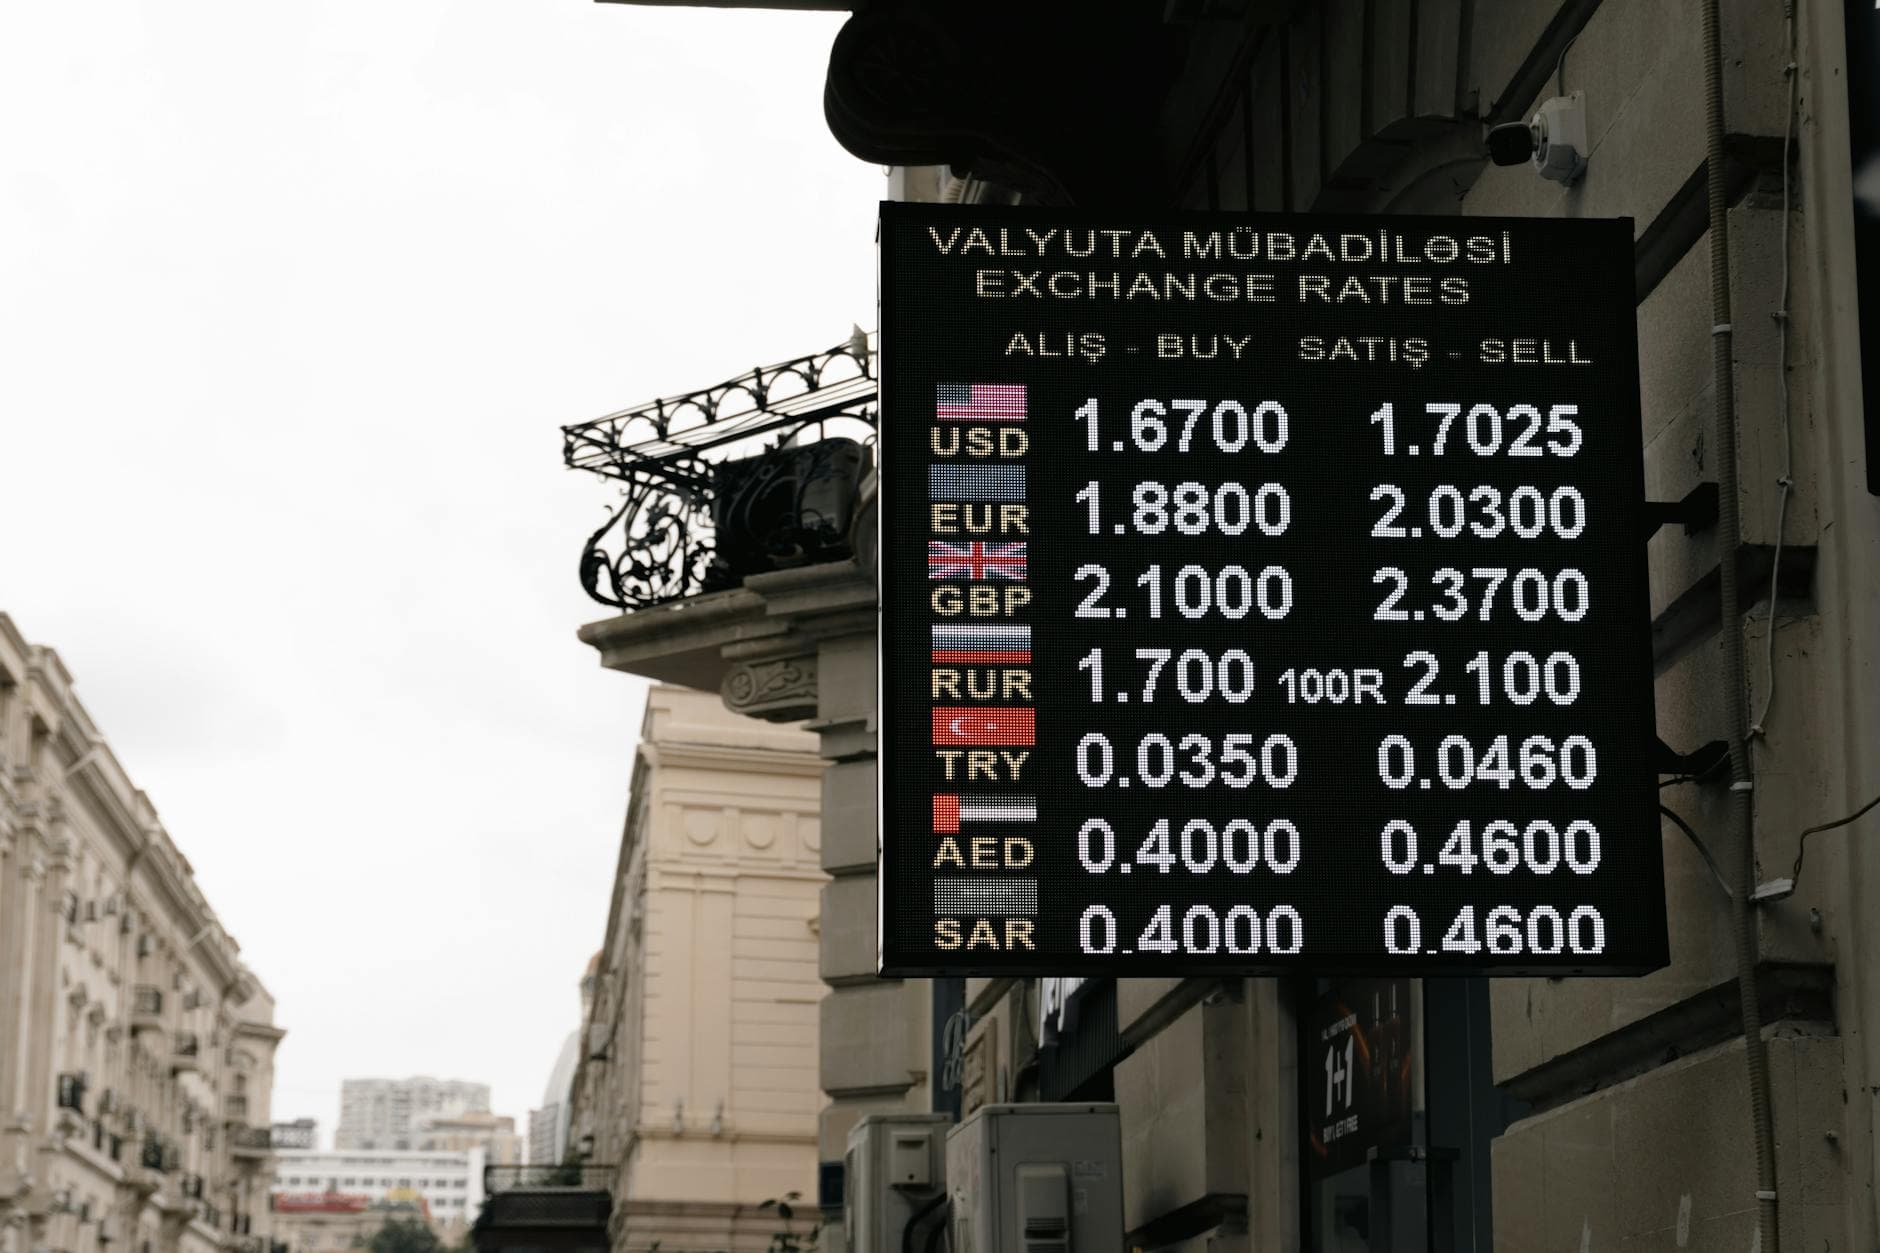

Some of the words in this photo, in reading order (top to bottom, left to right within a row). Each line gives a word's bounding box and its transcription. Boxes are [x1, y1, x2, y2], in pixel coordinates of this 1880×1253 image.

[929, 227, 1165, 258] VALYUTA
[977, 270, 1275, 301] EXCHANGE
[1299, 276, 1468, 304] RATES
[1006, 332, 1105, 365] ALIŞ
[1158, 334, 1250, 358] BUY
[1301, 336, 1427, 370] SATIŞ
[1480, 339, 1593, 363] SELL
[931, 427, 1028, 458] USD
[1075, 398, 1288, 453] 1.6700
[1371, 403, 1582, 456] 1.7025
[932, 504, 1029, 533] EUR
[1076, 481, 1290, 535] 1.8800
[1370, 484, 1585, 538] 2.0300
[932, 585, 1030, 616] GBP
[1074, 564, 1292, 619] 2.1000
[1373, 567, 1589, 621] 2.3700
[932, 669, 1031, 700] RUR
[1079, 648, 1254, 703] 1.700
[1279, 669, 1386, 704] 100R
[1404, 651, 1580, 705] 2.100
[936, 751, 1029, 780] TRY
[1077, 733, 1297, 788] 0.0350
[1378, 735, 1596, 789] 0.0460
[934, 837, 1033, 869] AED
[1078, 819, 1300, 873] 0.4000
[1381, 820, 1600, 874] 0.4600
[935, 918, 1035, 949] SAR
[1080, 905, 1302, 953] 0.4000
[1384, 905, 1605, 954] 0.4600
[1325, 1034, 1354, 1118] 1+1
